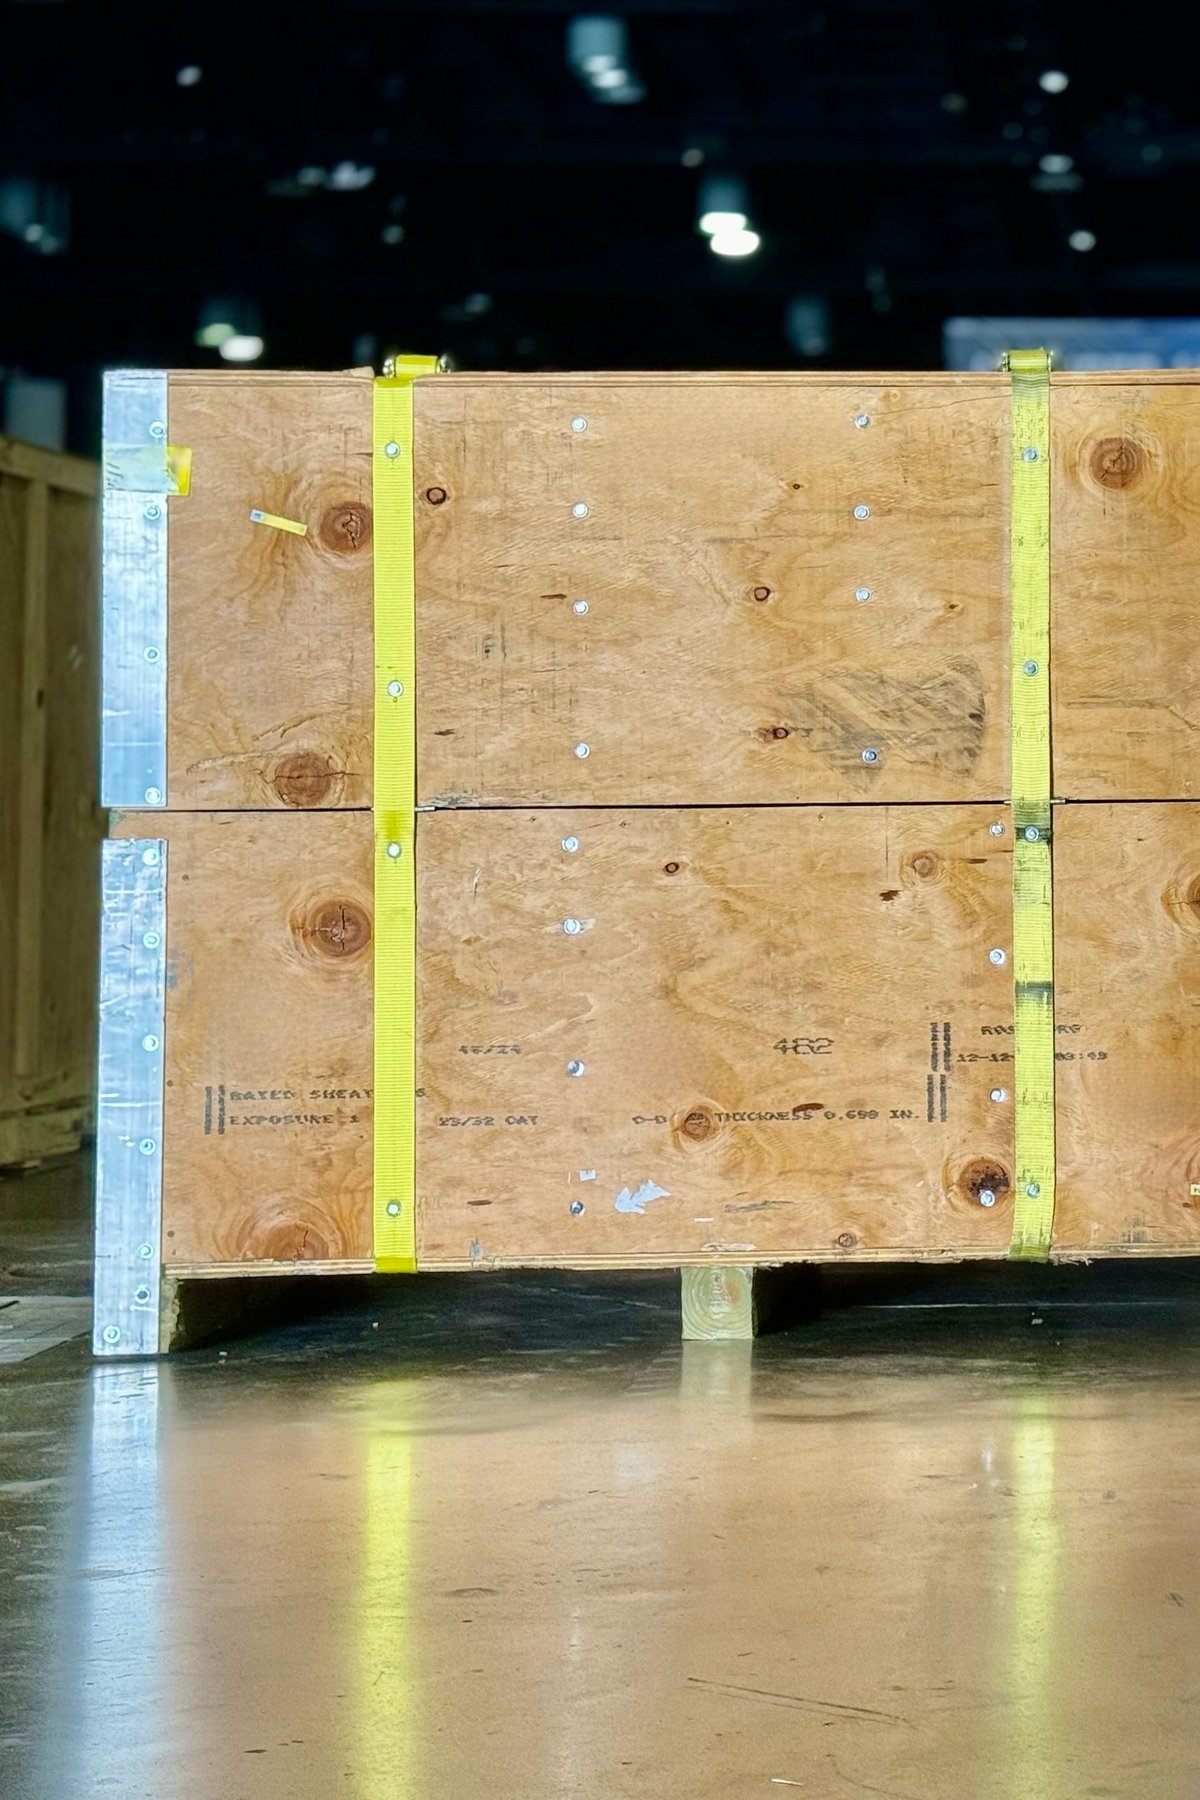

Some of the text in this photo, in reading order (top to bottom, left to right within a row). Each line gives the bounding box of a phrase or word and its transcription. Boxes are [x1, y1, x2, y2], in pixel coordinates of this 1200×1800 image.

[229, 1089, 297, 1101] RATED
[229, 1115, 334, 1126] EXPOSURE
[714, 1111, 815, 1123] THICKNESS
